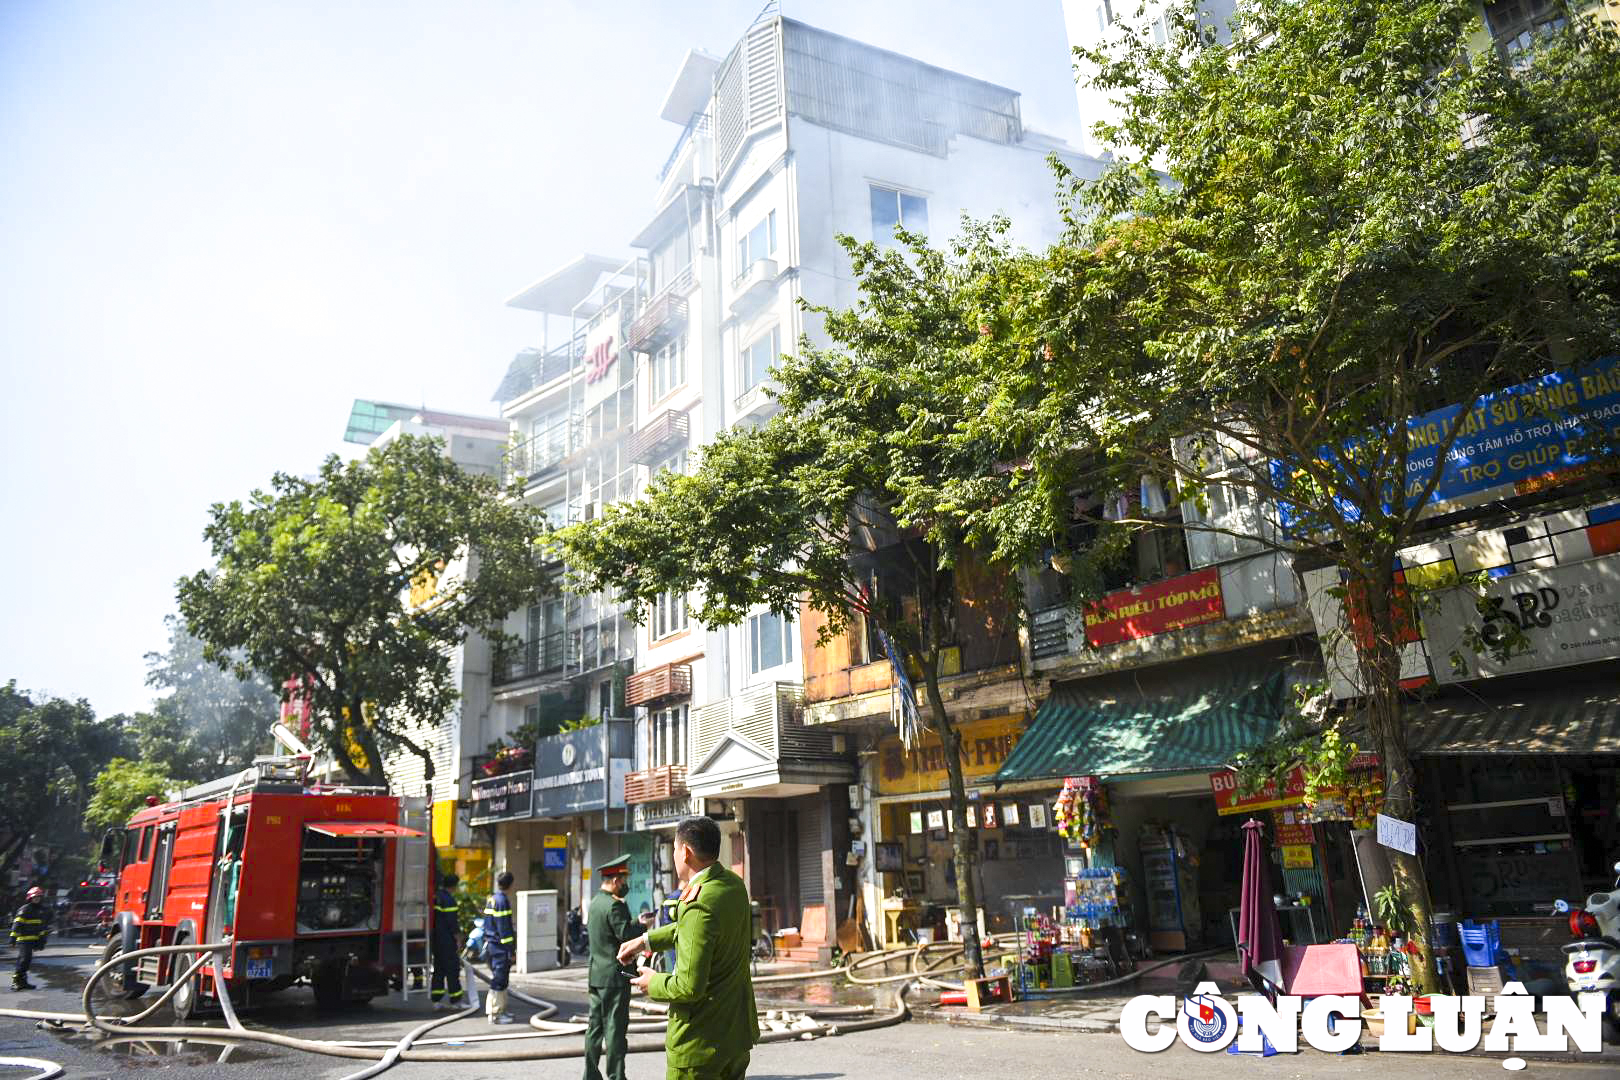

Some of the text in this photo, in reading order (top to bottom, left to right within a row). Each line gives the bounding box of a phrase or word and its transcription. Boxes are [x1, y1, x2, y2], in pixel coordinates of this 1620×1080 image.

[1477, 437, 1503, 453] TÂM
[1460, 459, 1501, 484] TRỢ
[1508, 440, 1560, 471] GIÚP
[634, 806, 661, 821] HOTEL
